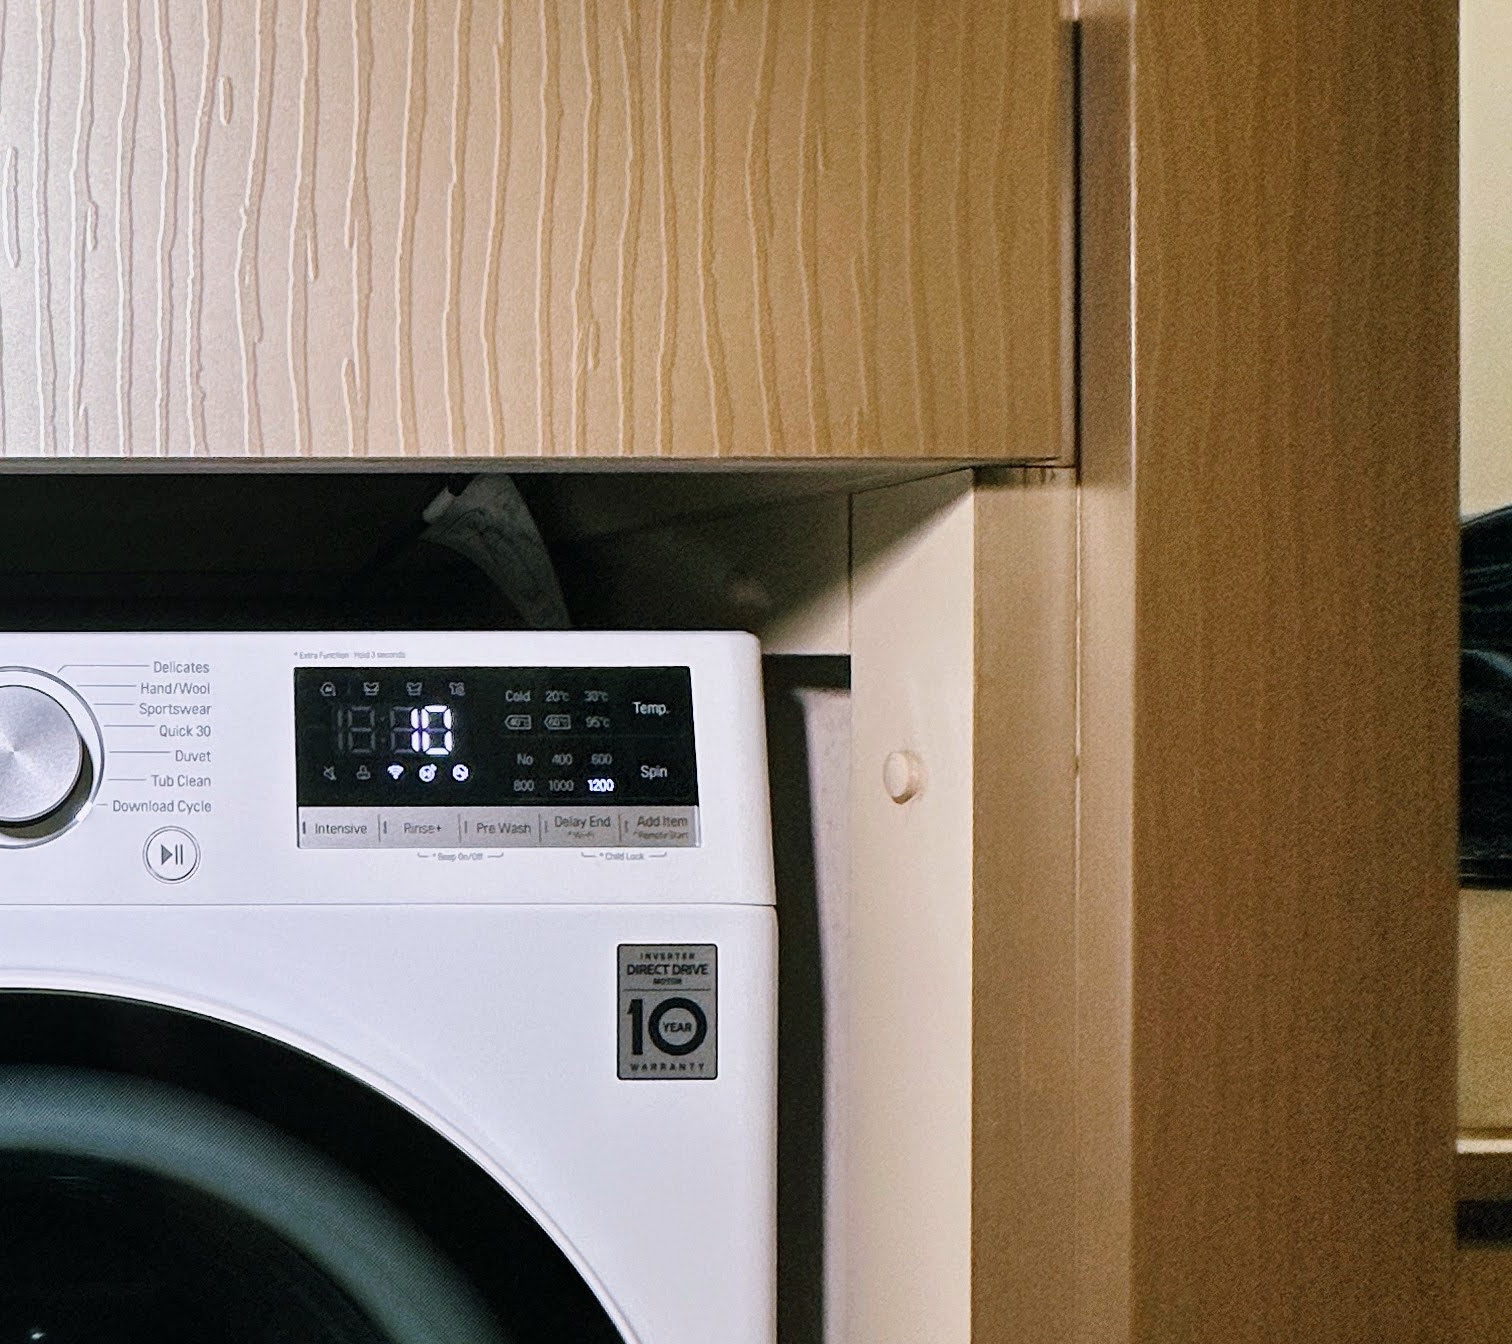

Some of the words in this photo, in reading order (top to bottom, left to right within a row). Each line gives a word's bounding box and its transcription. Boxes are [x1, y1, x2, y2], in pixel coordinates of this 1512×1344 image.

[153, 661, 210, 674] Delicates
[140, 682, 211, 695] Hand/Wool
[505, 689, 531, 702] Cold
[139, 702, 212, 717] Sportswear
[632, 701, 670, 716] Temp.
[159, 725, 194, 738] Quick
[196, 725, 212, 737] 30
[175, 749, 212, 762] Duvet
[517, 753, 534, 765] No
[552, 753, 573, 766] 400
[640, 765, 668, 780] Spin
[151, 774, 174, 787] Tub
[177, 774, 212, 788] Clean
[513, 779, 535, 792] 800
[548, 779, 574, 792] 1000
[588, 778, 615, 792] 1200
[112, 799, 175, 813] Download
[178, 799, 212, 815] Cycle
[554, 815, 587, 829] Delay
[589, 815, 611, 827] End
[637, 815, 660, 827] Add
[314, 822, 368, 835] Intensive
[476, 822, 496, 834] Pre
[498, 821, 532, 835] Wash
[626, 963, 669, 976] DIRECT
[672, 963, 709, 976] DRIVE
[626, 996, 708, 1057] 10
[662, 1022, 692, 1033] YEAR
[629, 1063, 705, 1072] WARRANTY
